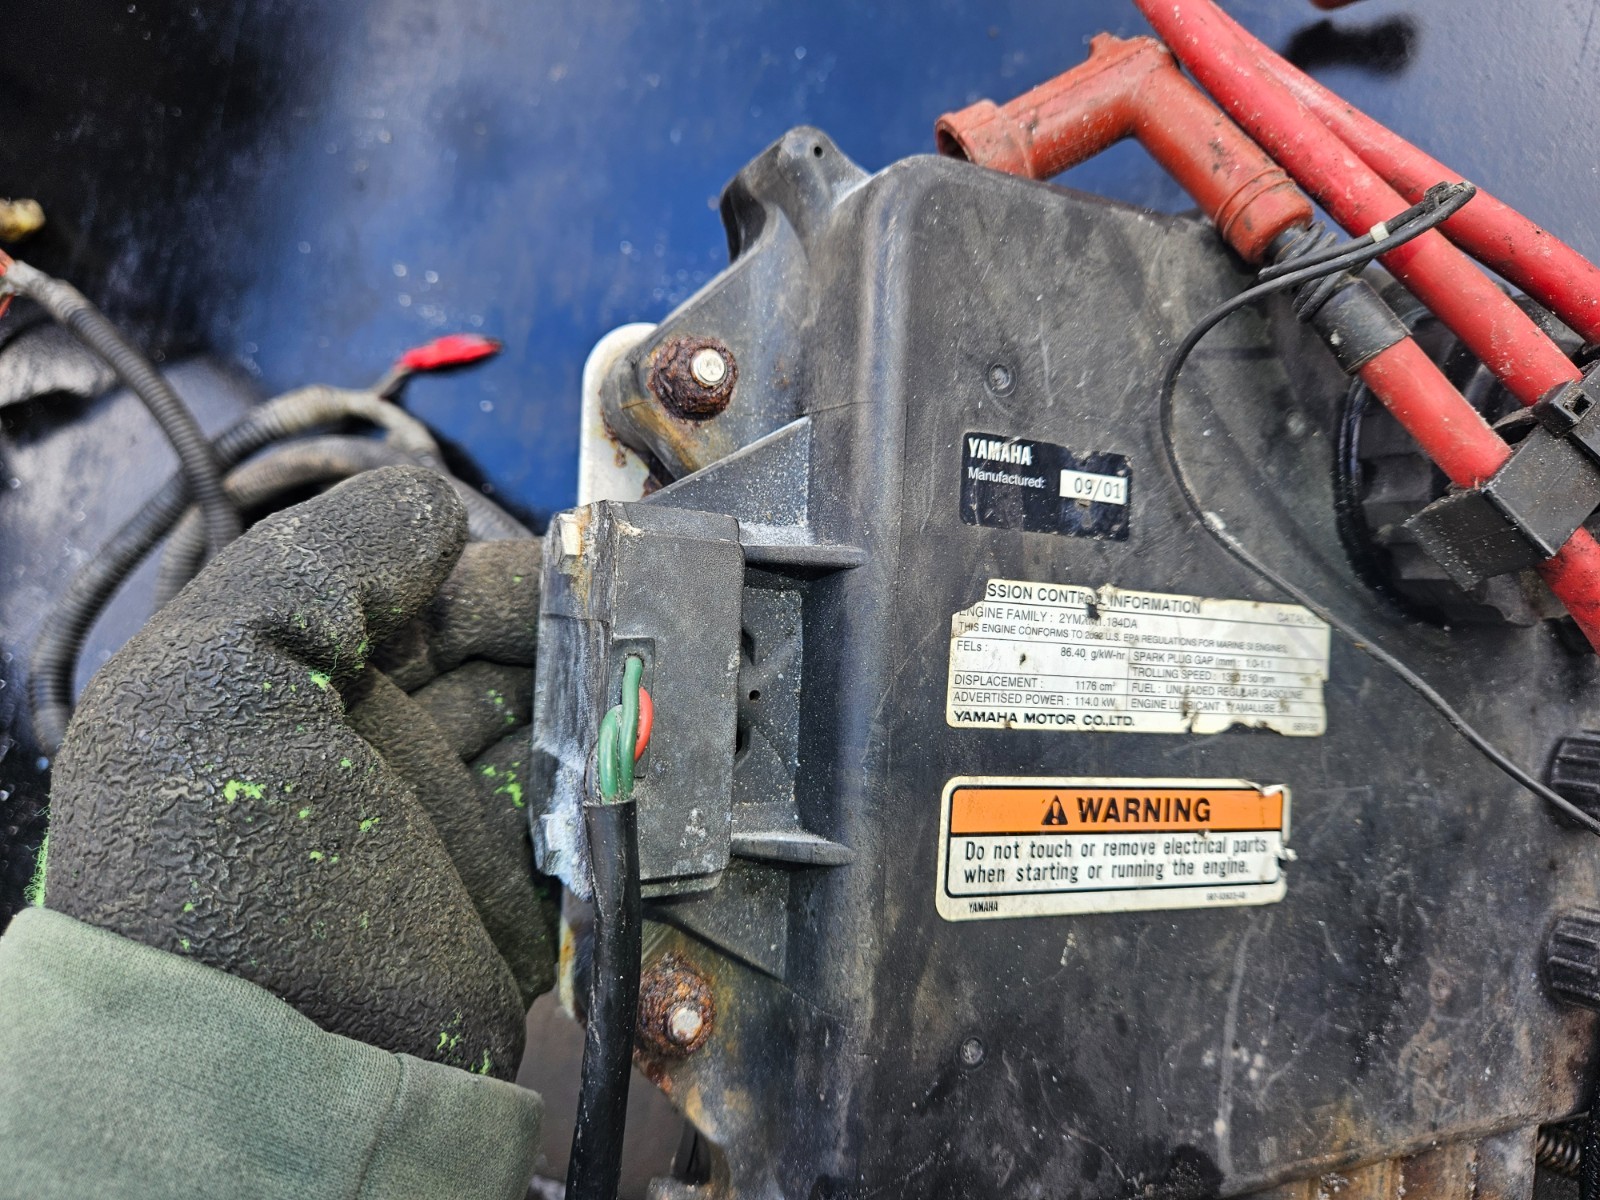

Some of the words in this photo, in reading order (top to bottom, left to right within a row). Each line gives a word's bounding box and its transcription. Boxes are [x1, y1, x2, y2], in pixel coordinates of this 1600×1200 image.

[968, 437, 1032, 466] YAMAHA
[968, 467, 1045, 489] Manufactured:
[1074, 477, 1121, 499] 09/01
[1110, 595, 1201, 614] INFORMATION
[959, 606, 1003, 619] ENGINE
[1006, 608, 1047, 622] FAMILY
[958, 621, 979, 632] THIS
[982, 624, 1016, 635] ENGINE
[1018, 625, 1069, 638] CONFORMS
[1072, 629, 1083, 639] TO
[1123, 633, 1139, 643] EPA
[1141, 635, 1197, 647] REGULATIONS
[1198, 638, 1215, 648] FOR
[1216, 640, 1244, 650] MARINE
[956, 640, 982, 652] FELs
[1061, 647, 1086, 658] 86.40
[1090, 649, 1126, 661] g/kW-hr
[1133, 651, 1165, 662] SPARK
[1167, 654, 1192, 665] PLUG
[1194, 655, 1214, 665] GAP
[1133, 666, 1179, 678] TROLLING
[1181, 670, 1212, 680] SPEED
[954, 674, 1038, 688] DISPLACEMENT
[1075, 680, 1097, 691] 1176
[1131, 683, 1155, 693] FUEL
[1166, 685, 1215, 696] UNLEADED
[1217, 687, 1259, 698] REGULAR
[953, 691, 1023, 704] ADVERTISED
[1026, 694, 1064, 706] POWER
[1074, 695, 1098, 707] 114.0
[1101, 696, 1115, 707] kW
[1131, 698, 1166, 709] ENGINE
[1169, 700, 1221, 711] LUBRICANT
[953, 710, 1018, 724] YAMAHA
[1023, 713, 1076, 725] MOTOR
[1077, 796, 1211, 824] WARNING
[965, 840, 985, 861] Do
[993, 840, 1020, 860] not
[1030, 838, 1073, 859] touch
[1081, 842, 1096, 857] or
[1103, 840, 1155, 857] remove
[1163, 836, 1226, 855] electrical
[1233, 837, 1267, 857] parts
[964, 864, 1006, 883] when
[1016, 861, 1079, 884] starting
[1087, 865, 1103, 880] or
[1111, 860, 1164, 882] running
[1173, 857, 1195, 876] the
[1203, 860, 1250, 878] engine.
[968, 901, 999, 913] YAMAHA
